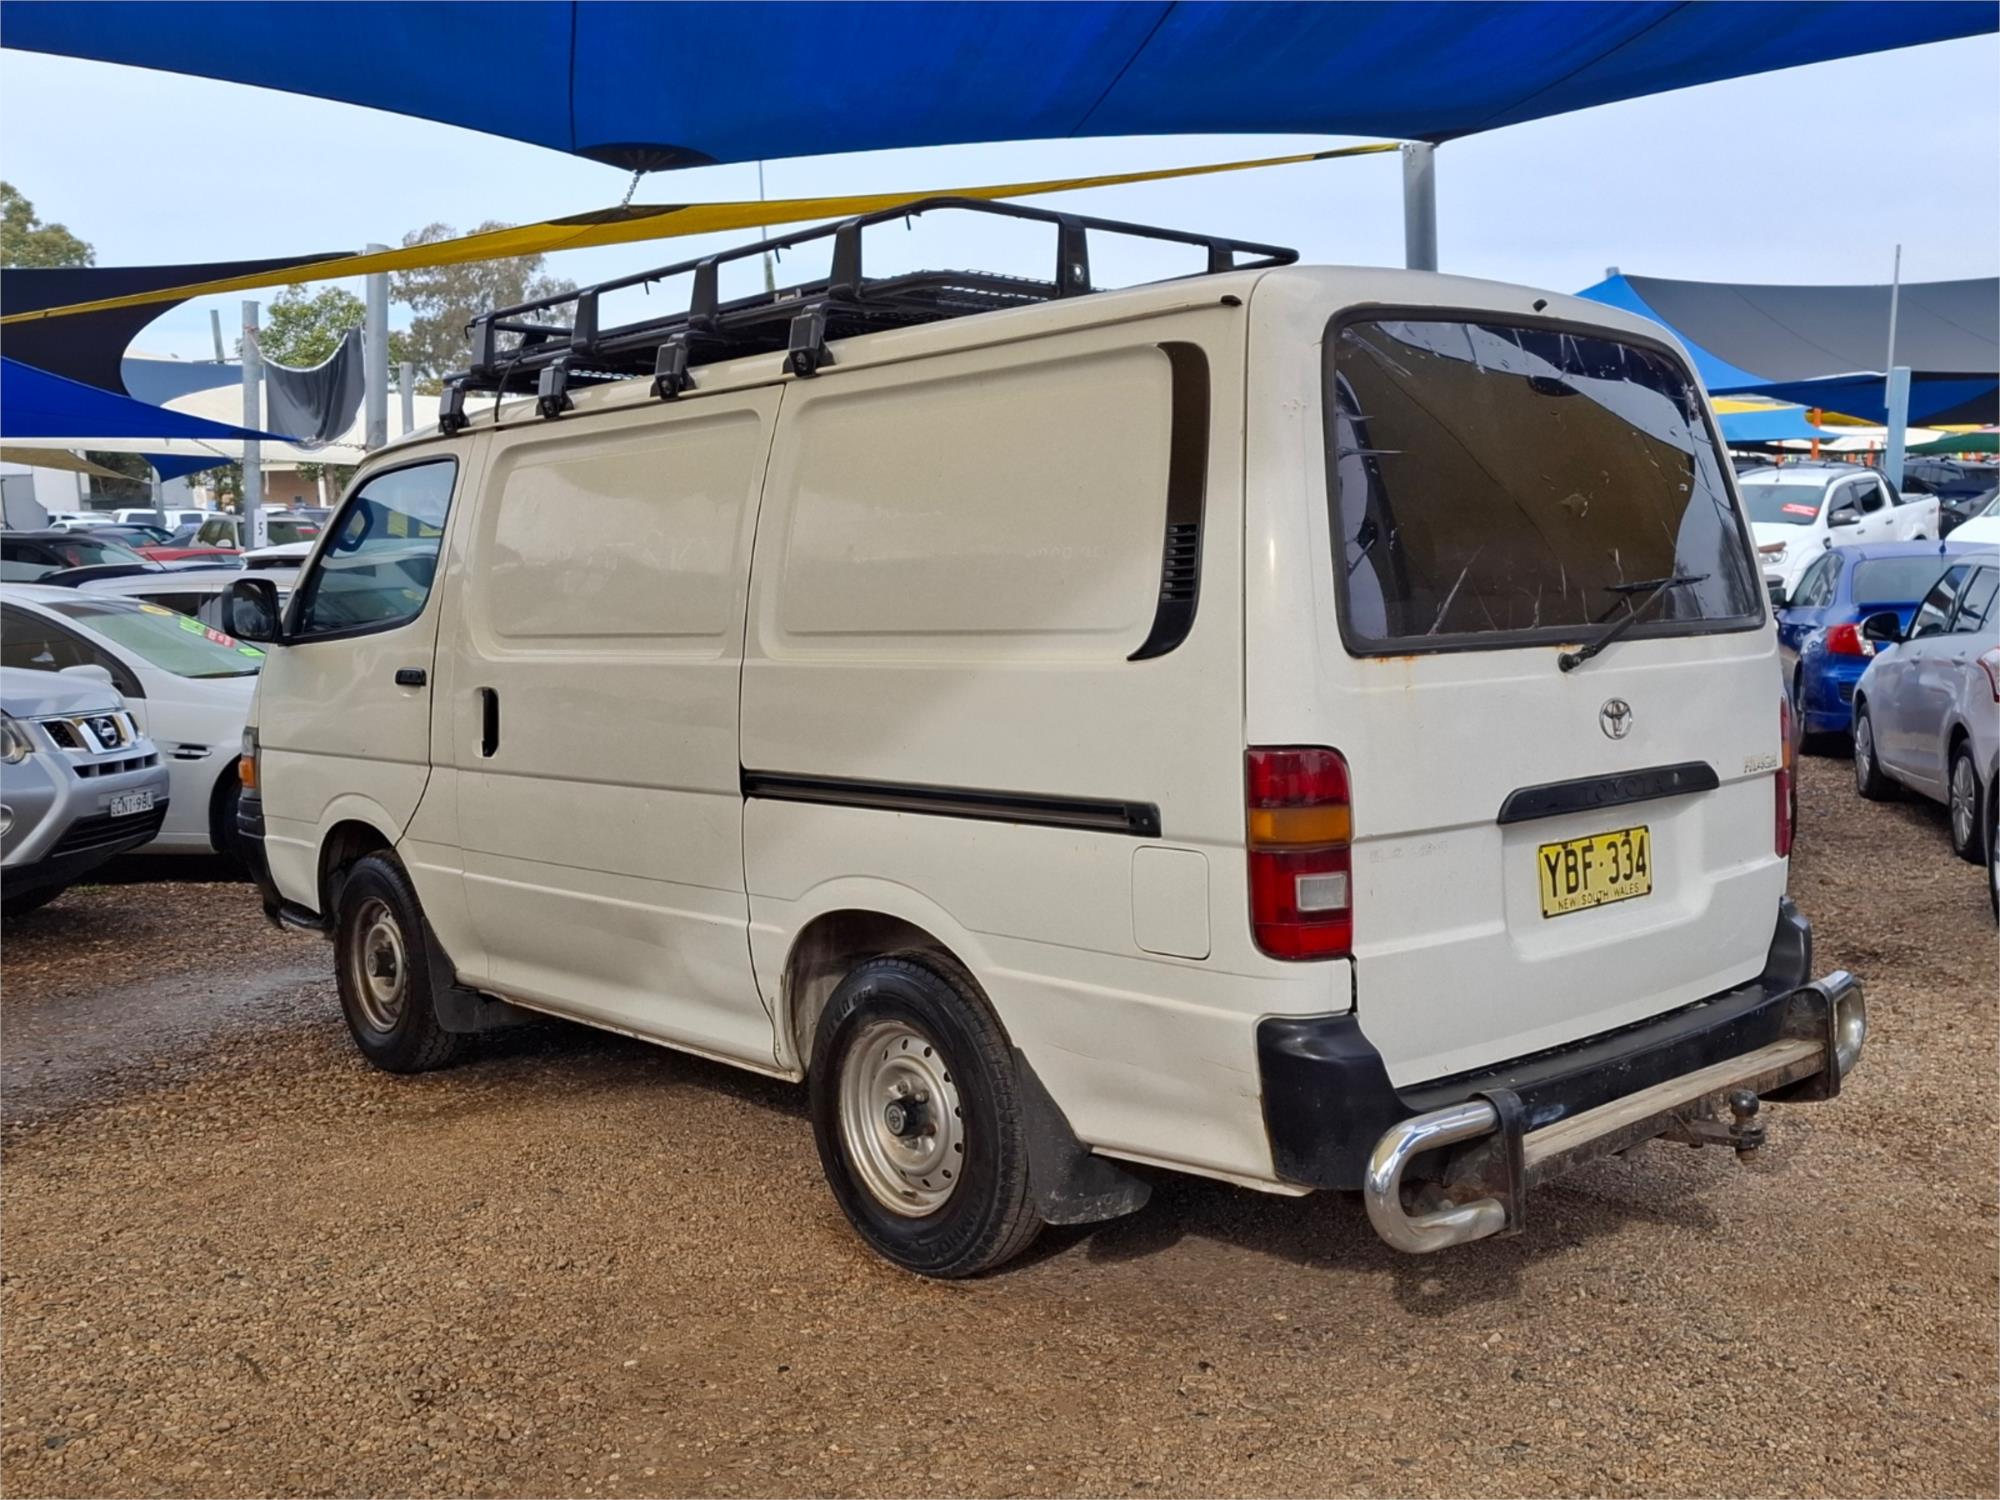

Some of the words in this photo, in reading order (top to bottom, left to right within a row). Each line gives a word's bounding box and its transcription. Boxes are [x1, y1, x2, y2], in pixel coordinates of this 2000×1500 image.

[1558, 897, 1576, 911] NEW
[1581, 889, 1609, 905] SOUTH
[1614, 882, 1640, 897] WALES
